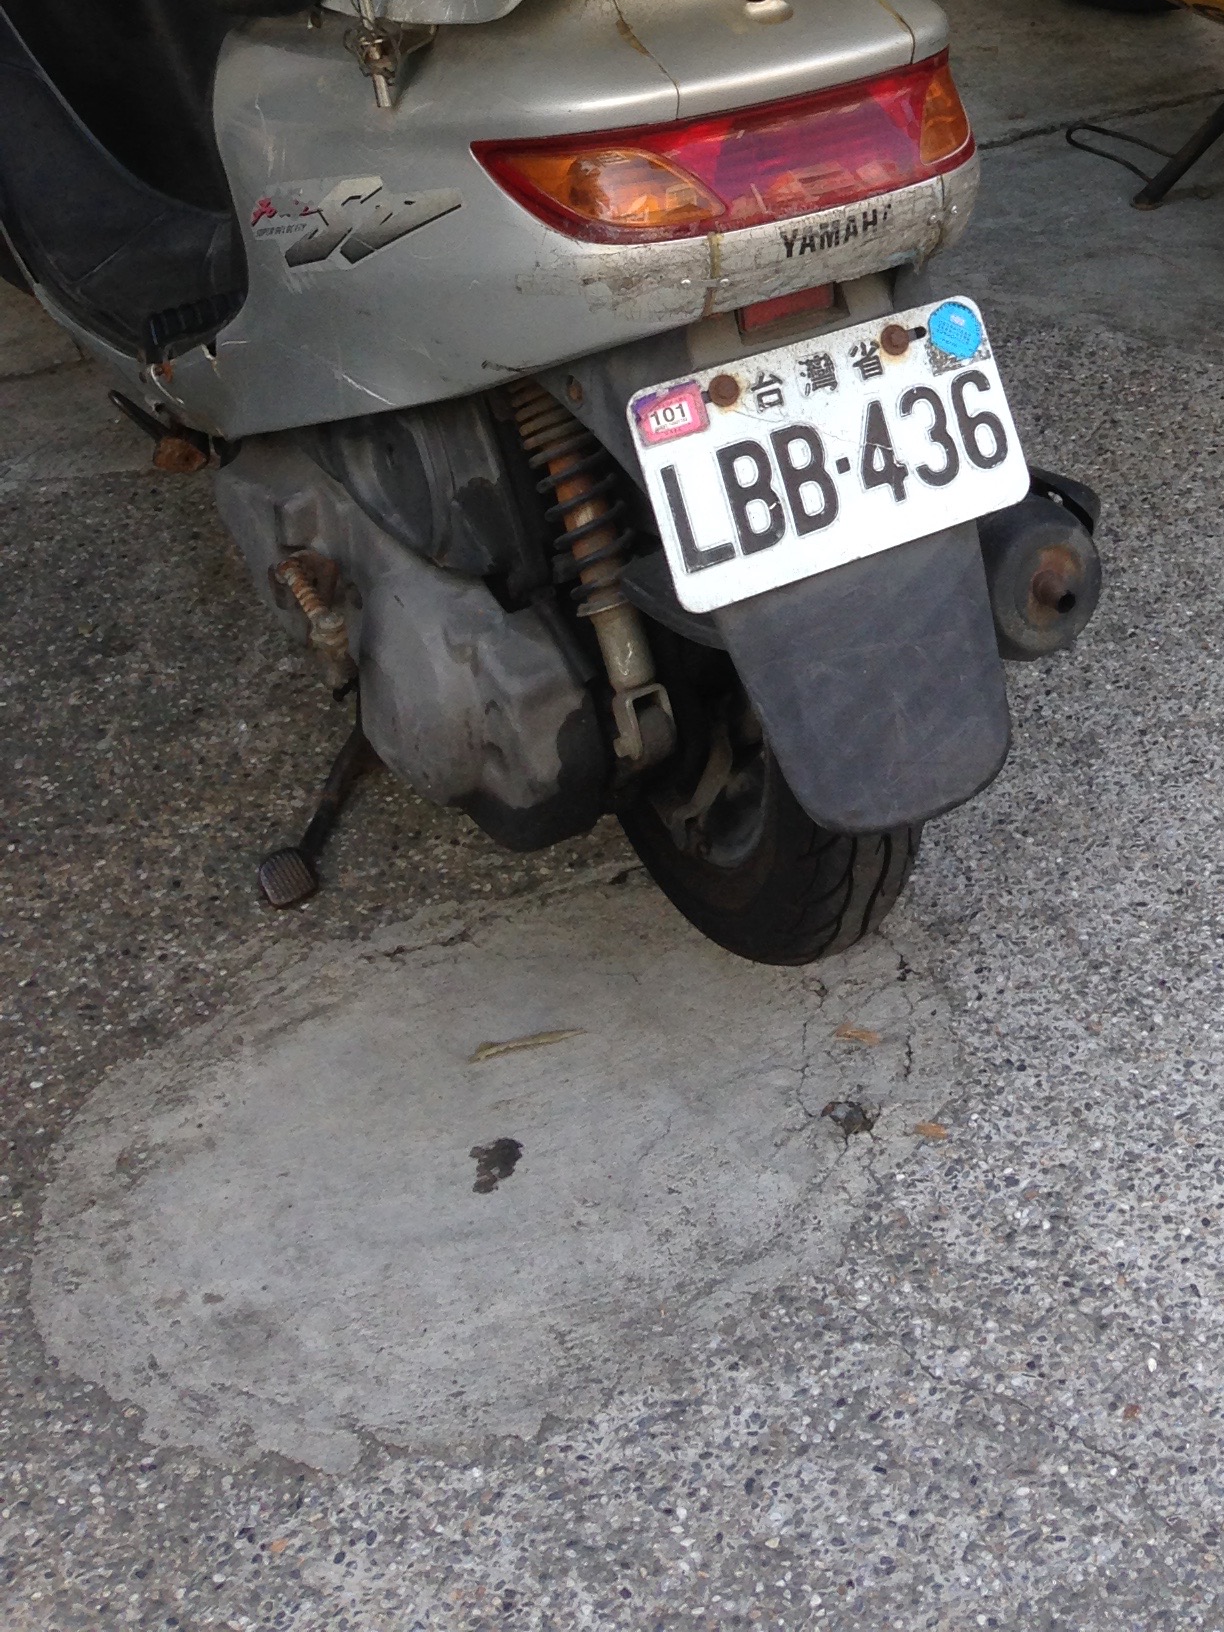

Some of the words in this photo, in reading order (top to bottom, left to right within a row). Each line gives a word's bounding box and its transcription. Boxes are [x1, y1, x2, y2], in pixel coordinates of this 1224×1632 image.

[749, 339, 884, 413] 台灣省
[650, 403, 686, 426] 101
